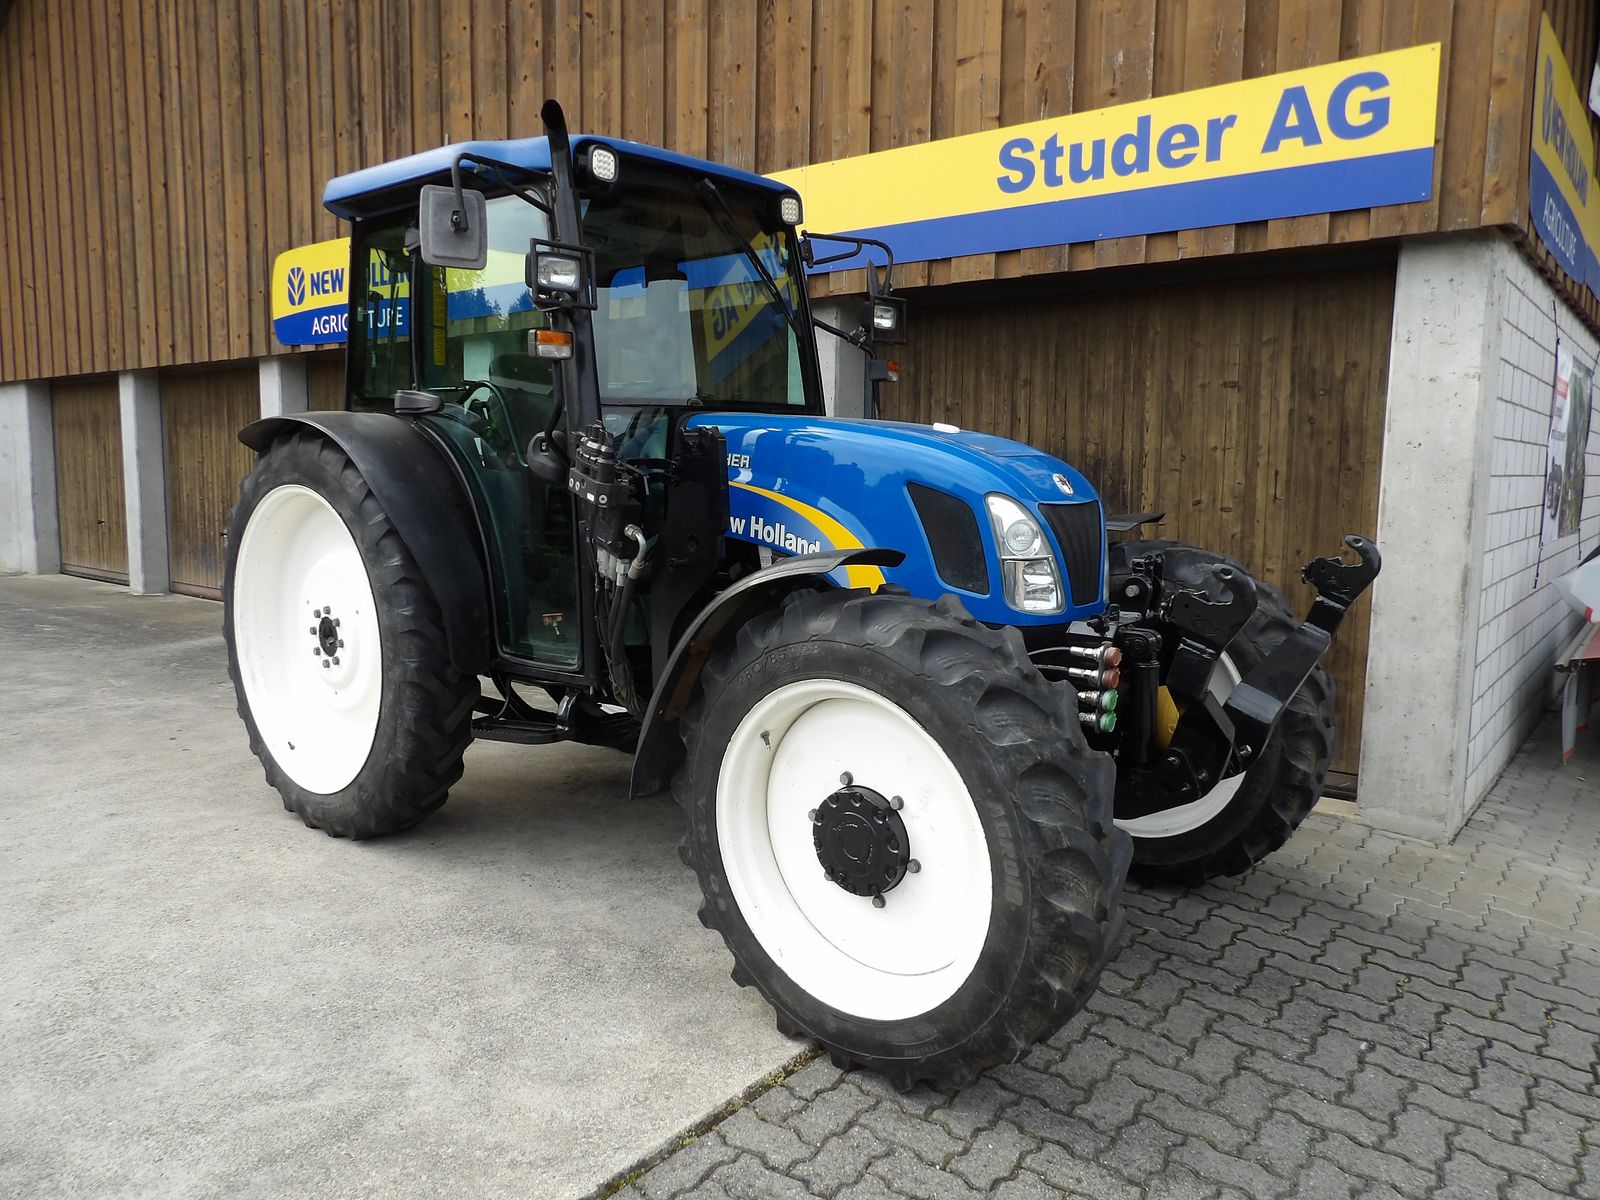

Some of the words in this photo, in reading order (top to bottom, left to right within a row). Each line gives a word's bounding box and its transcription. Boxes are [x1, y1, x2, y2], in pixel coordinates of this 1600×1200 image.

[997, 113, 1238, 194] Studer
[1260, 70, 1391, 154] AG
[310, 267, 345, 297] NEW
[749, 515, 821, 555] Holland
